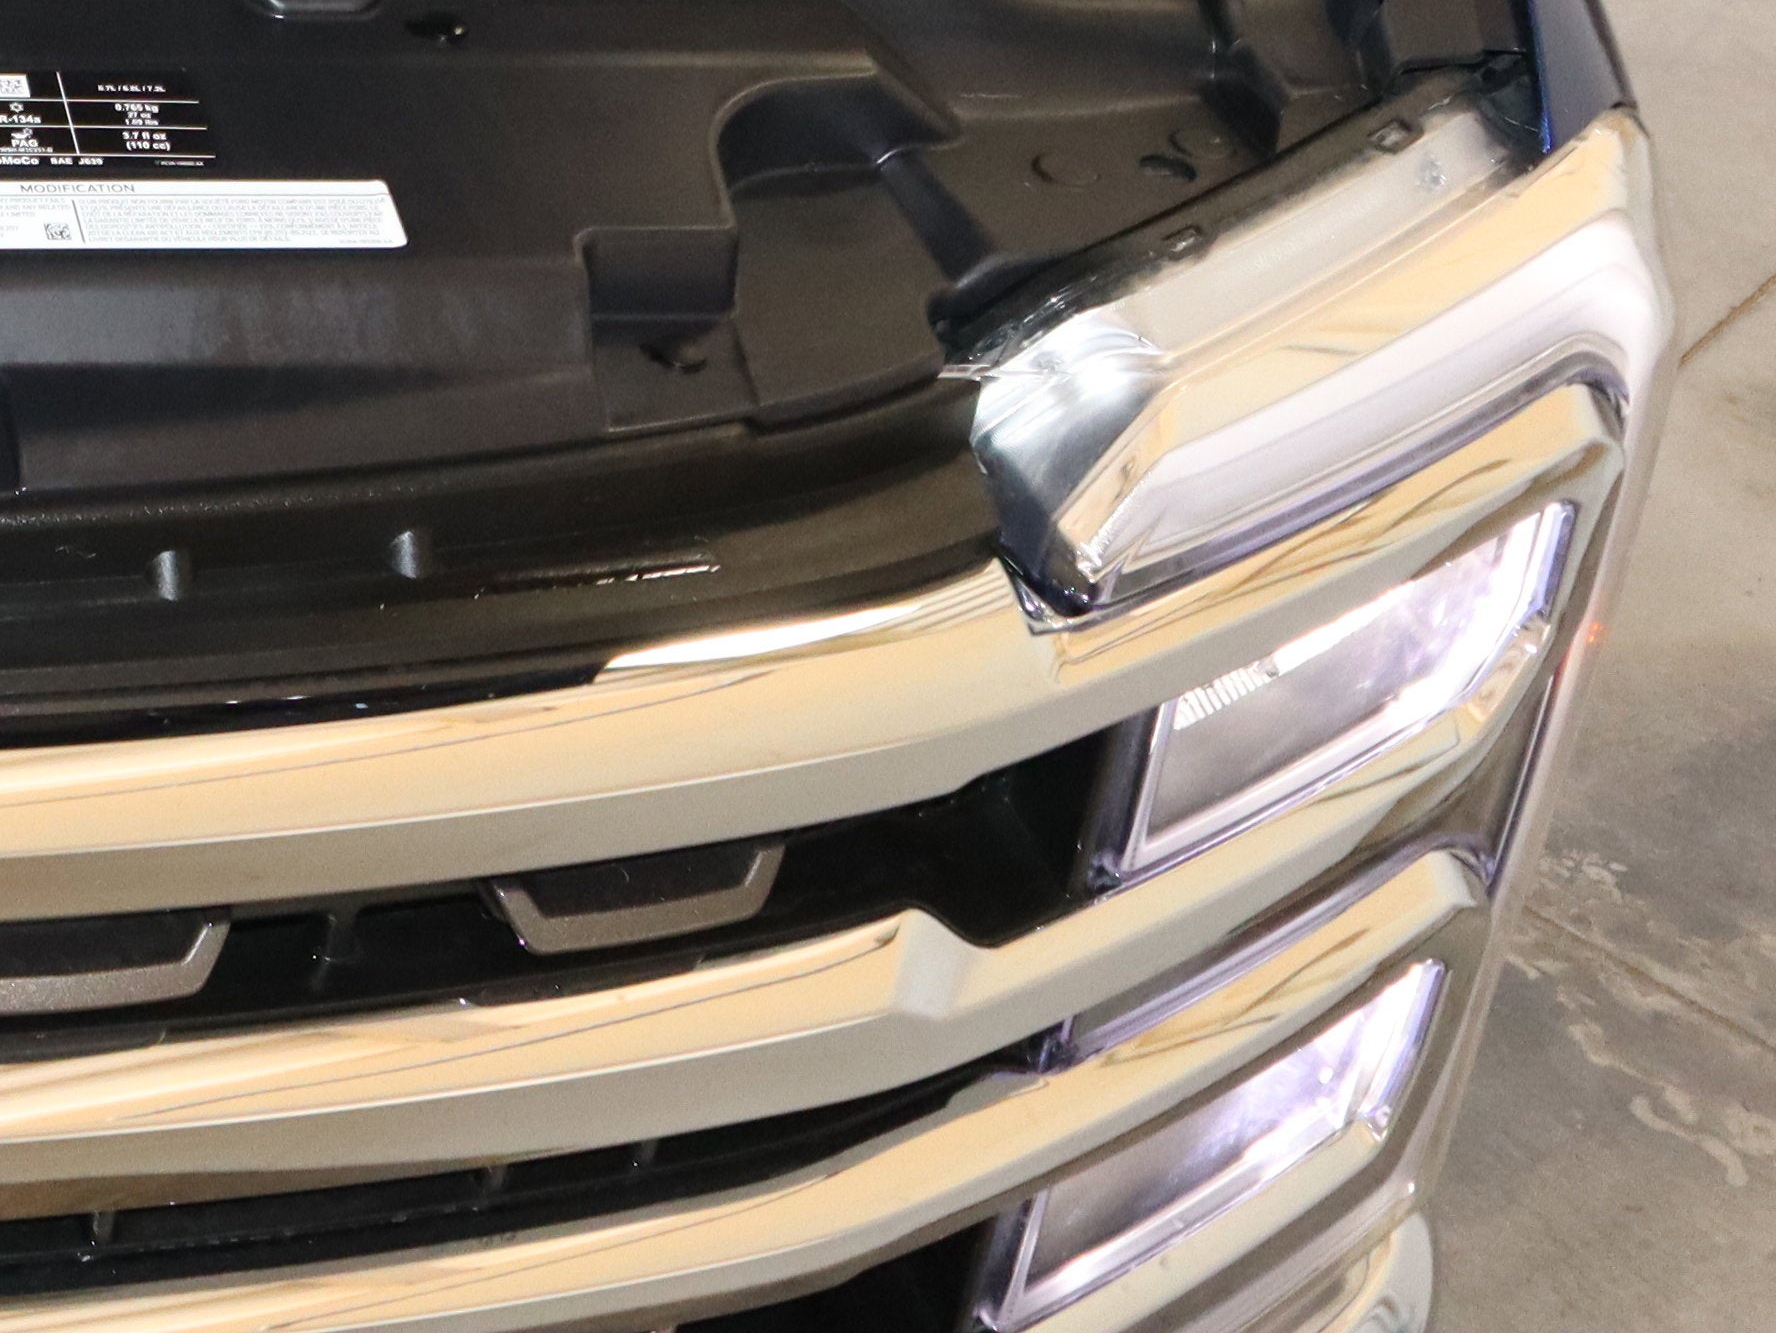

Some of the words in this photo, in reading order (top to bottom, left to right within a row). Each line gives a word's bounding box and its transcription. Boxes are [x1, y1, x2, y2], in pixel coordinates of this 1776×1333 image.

[11, 138, 39, 148] PAG
[126, 140, 150, 151] (110
[152, 141, 171, 152] cc)
[50, 156, 74, 165] SAE
[19, 184, 136, 194] MODIFICATION
